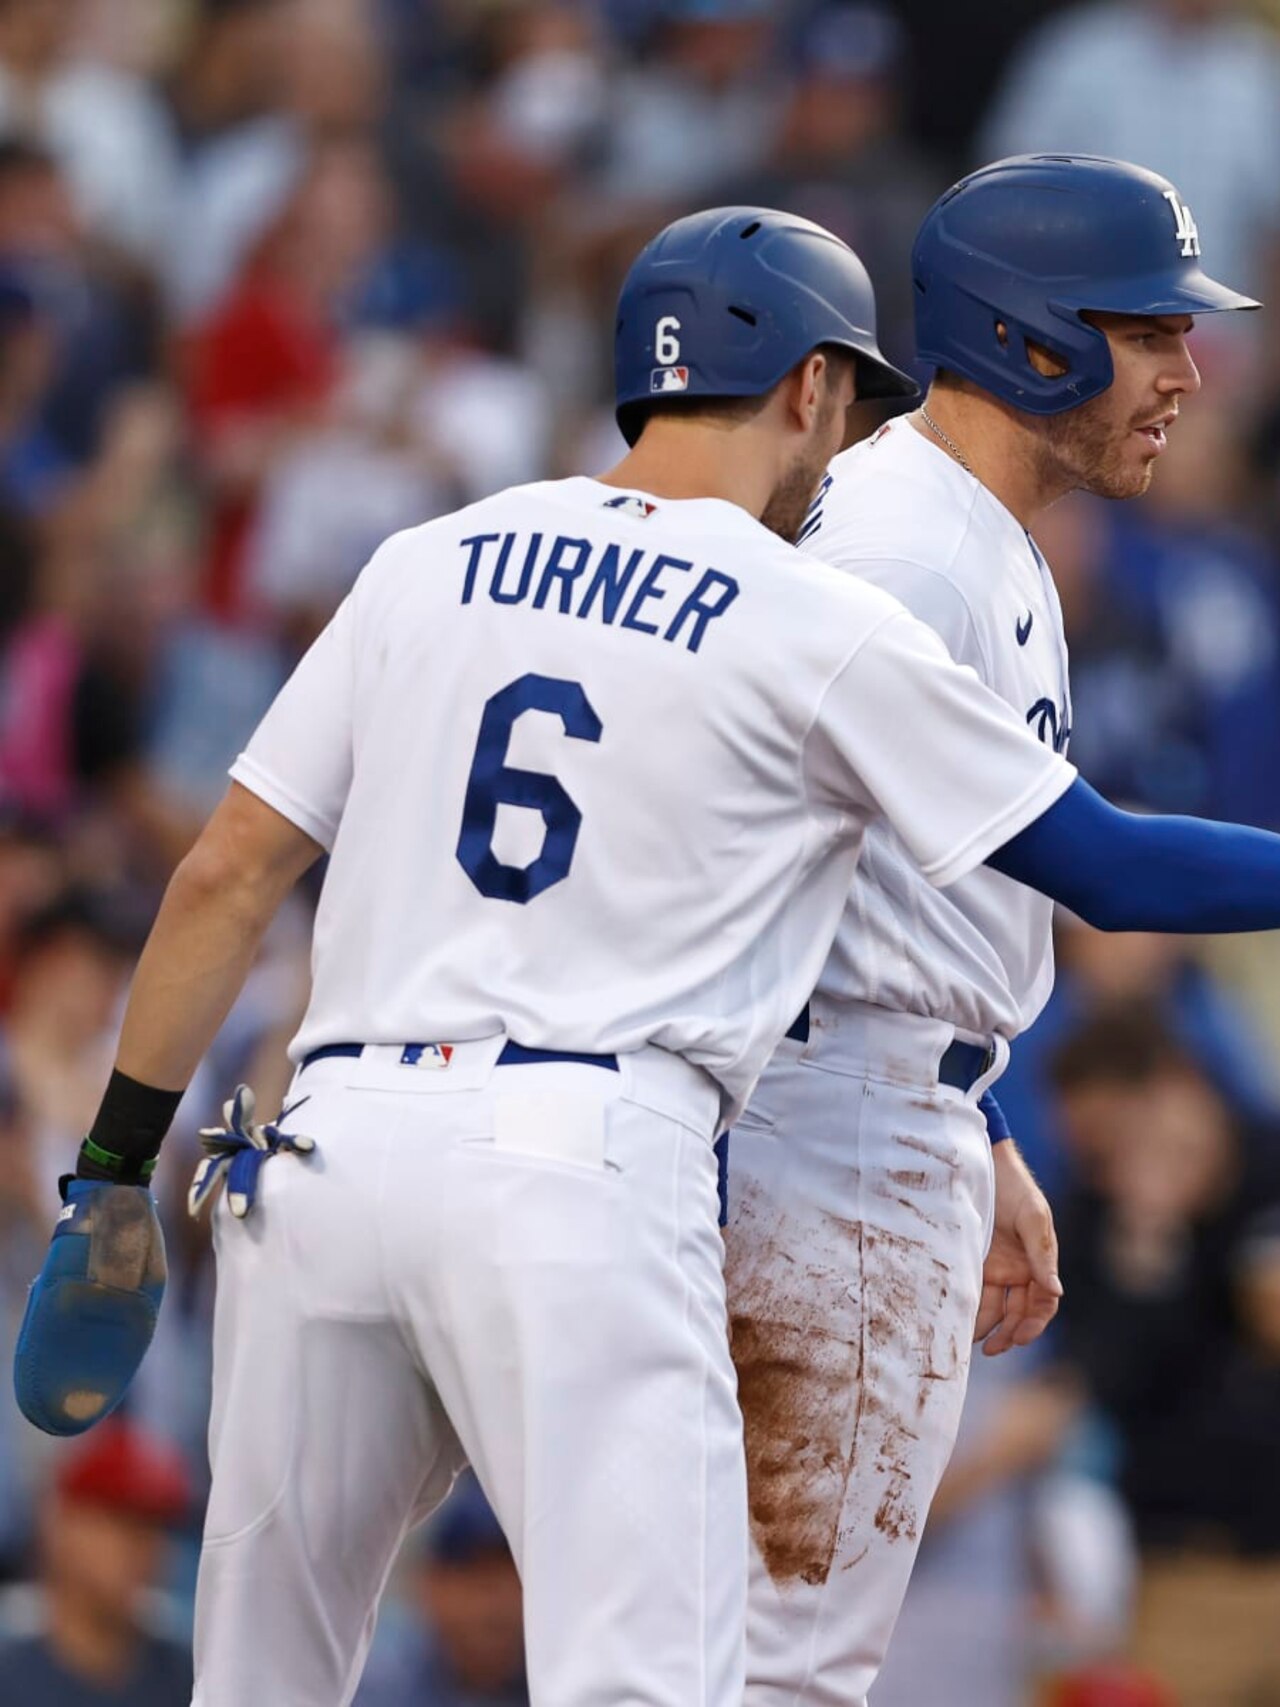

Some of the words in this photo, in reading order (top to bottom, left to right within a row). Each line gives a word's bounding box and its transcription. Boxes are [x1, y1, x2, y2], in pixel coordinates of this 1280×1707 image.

[1162, 190, 1201, 257] LA
[655, 316, 681, 365] 6
[460, 532, 740, 654] TURNER
[456, 672, 603, 905] 6
